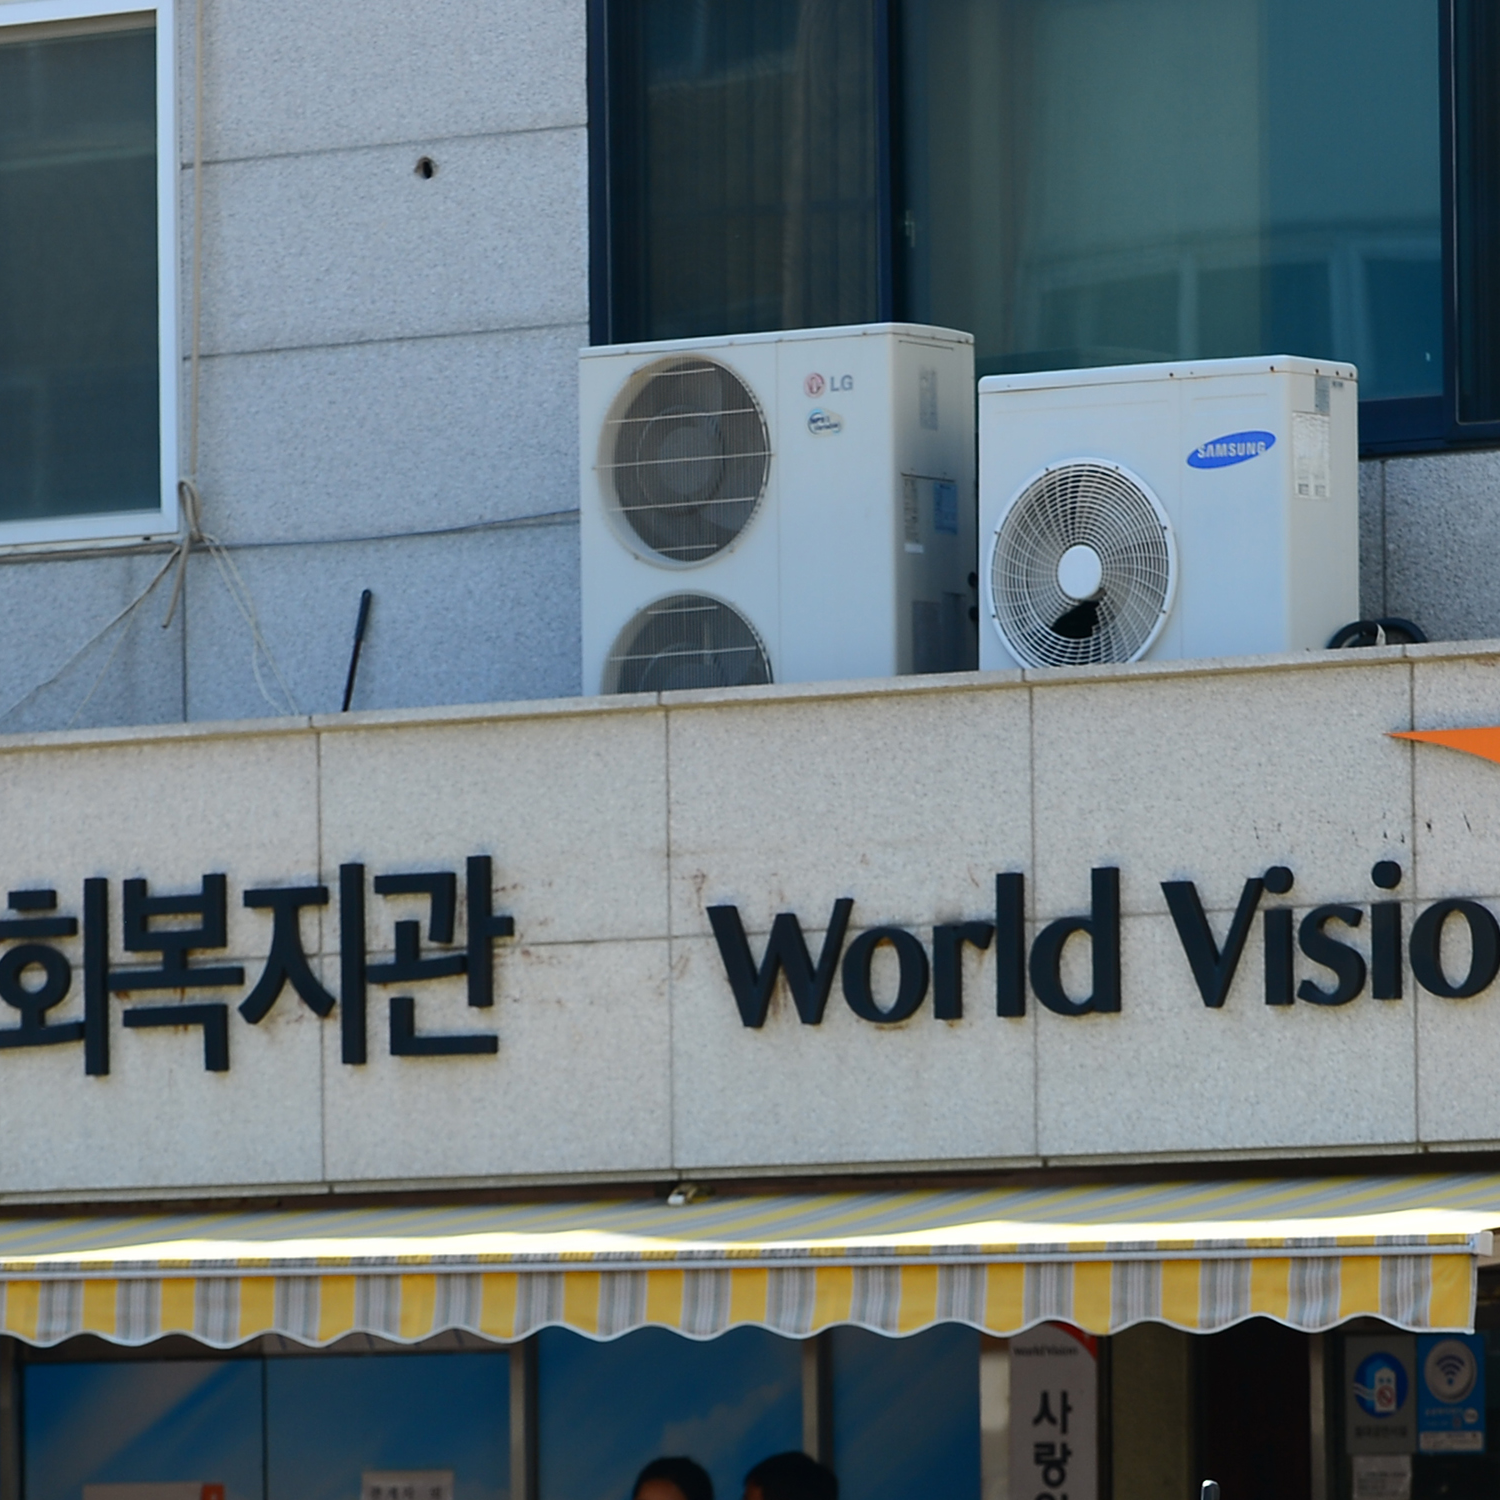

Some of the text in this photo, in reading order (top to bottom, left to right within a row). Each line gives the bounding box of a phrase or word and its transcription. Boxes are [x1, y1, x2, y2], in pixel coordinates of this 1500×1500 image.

[830, 374, 854, 392] LG
[1197, 441, 1267, 459] SAMSUNG
[705, 866, 1123, 1030] World
